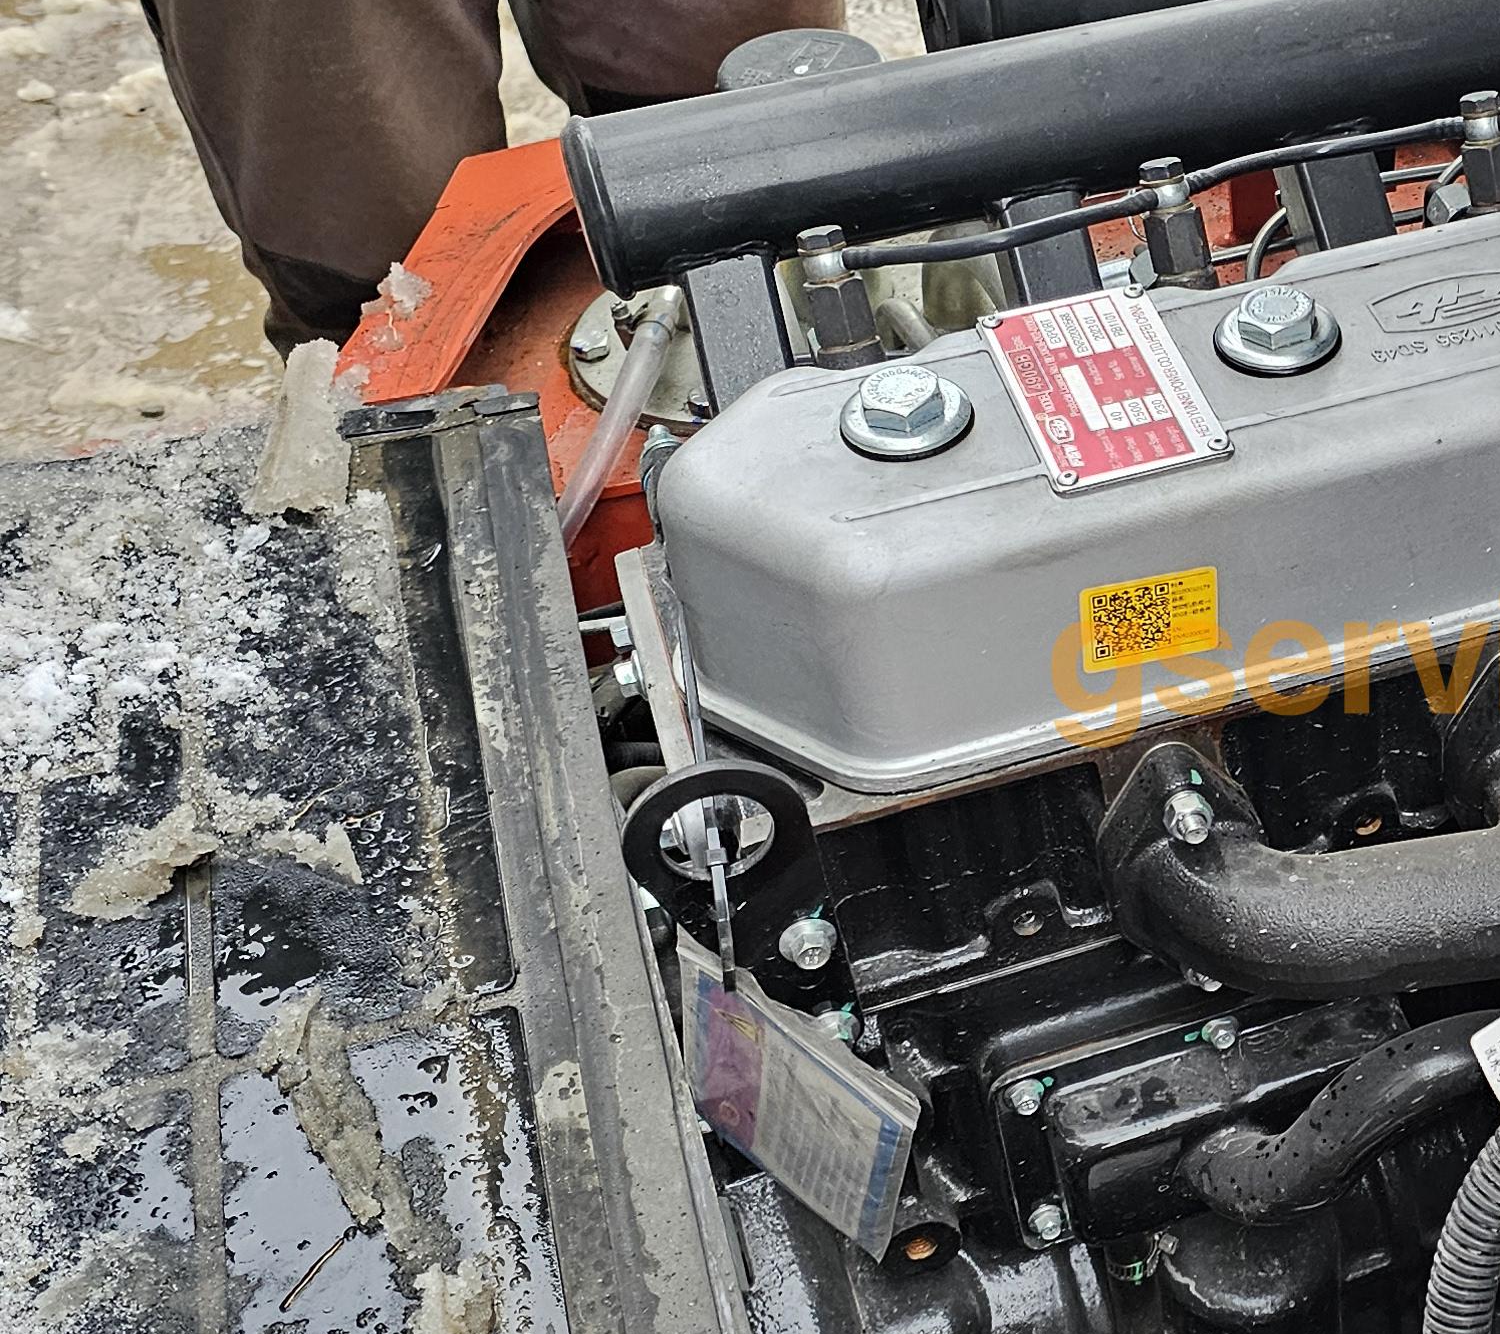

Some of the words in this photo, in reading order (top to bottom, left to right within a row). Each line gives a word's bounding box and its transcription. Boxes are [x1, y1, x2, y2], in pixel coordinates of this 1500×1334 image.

[1014, 354, 1044, 389] 490GB
[1127, 401, 1147, 421] 2500
[1150, 399, 1168, 414] 230
[1109, 411, 1124, 421] 40
